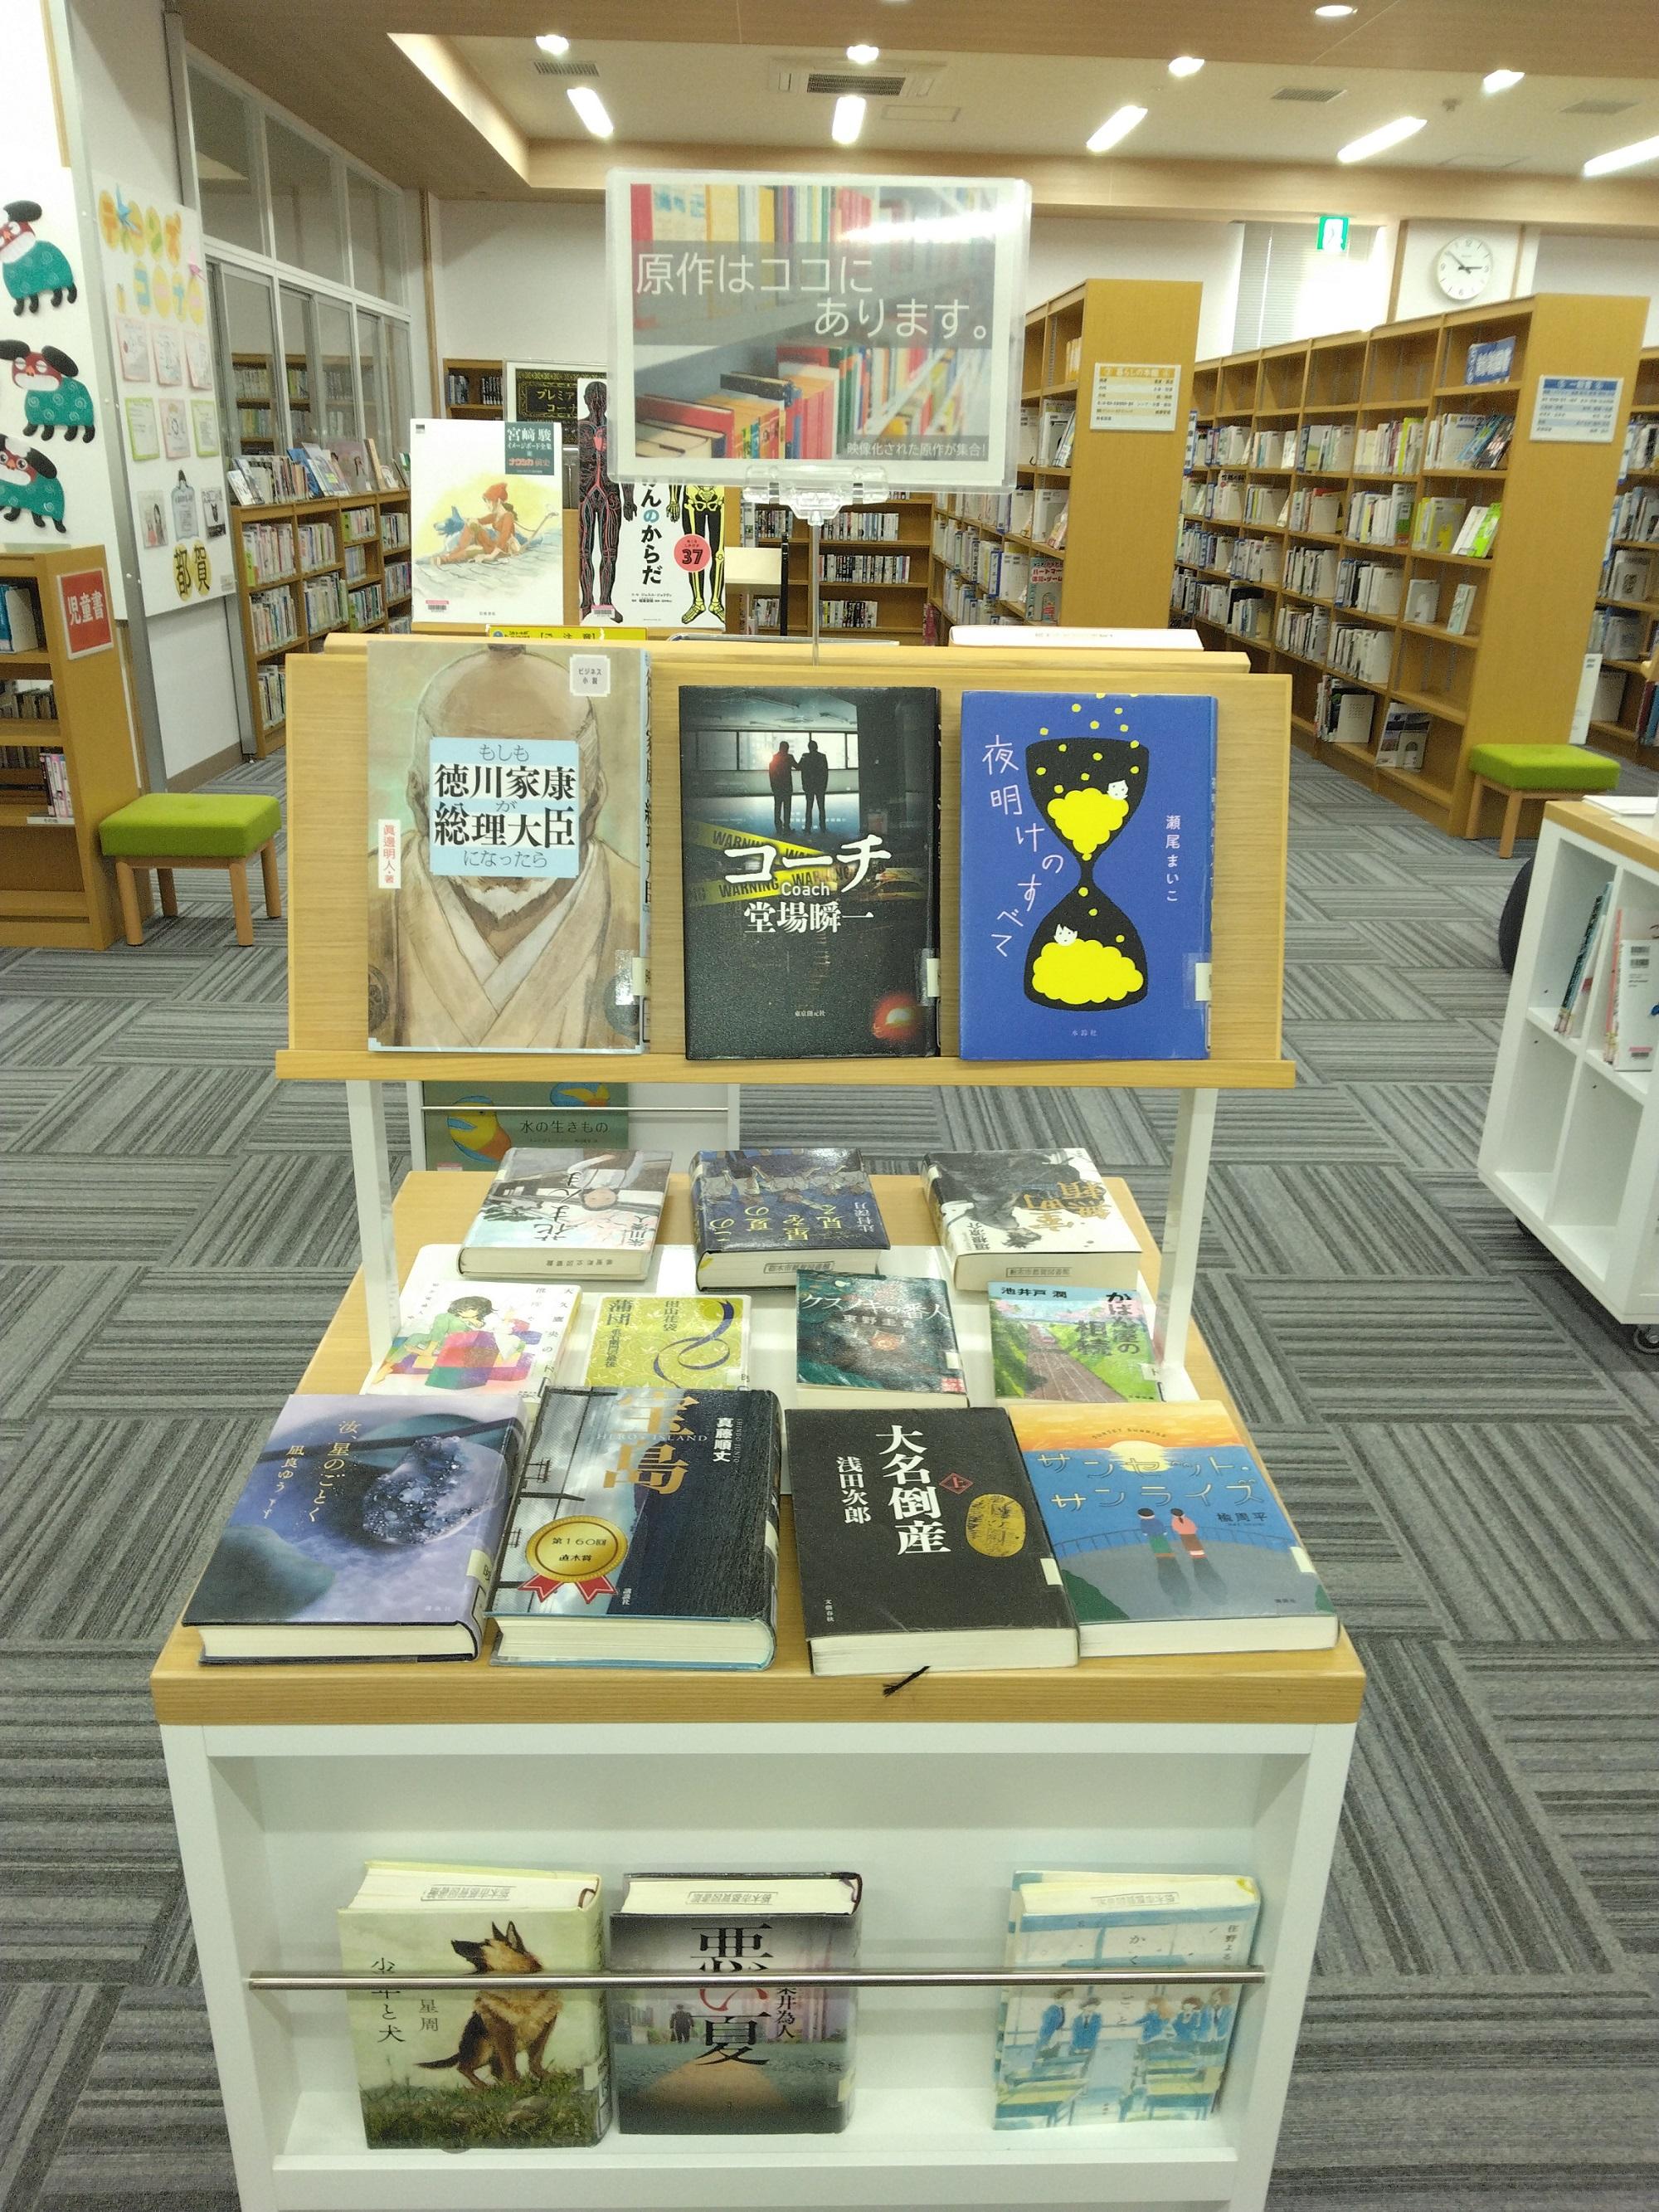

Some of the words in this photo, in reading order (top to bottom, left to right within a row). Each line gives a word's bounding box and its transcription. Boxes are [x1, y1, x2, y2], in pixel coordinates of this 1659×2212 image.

[635, 251, 873, 295] 原作はココに
[814, 297, 987, 340] あります。
[537, 389, 576, 401] プレミア
[547, 403, 578, 413] コーナ
[173, 544, 212, 597] 都賀
[682, 548, 703, 565] 37
[69, 589, 105, 626] 児童書
[577, 667, 603, 676] ビジネス
[581, 676, 599, 685] 小説
[478, 743, 530, 762] もしも
[434, 763, 577, 801] 徳川家康
[495, 799, 518, 814] が
[433, 801, 576, 850] 総理大臣
[463, 850, 548, 869] になったら
[723, 834, 893, 894] コーチ
[1165, 814, 1181, 903] 瀬尾まいこ
[781, 882, 830, 897] Coach
[743, 901, 874, 934] 堂場瞬一
[518, 1119, 609, 1134] 水の生きもの
[533, 1171, 584, 1242] 花まんま
[816, 1203, 845, 1230] 見る
[1056, 1181, 1113, 1220] 無頼
[708, 1217, 735, 1242] この
[744, 1205, 772, 1232] 夏の
[782, 1214, 810, 1241] 星を
[801, 1294, 951, 1322] クスノキの番人
[1000, 1286, 1047, 1297] 池井戸
[1052, 1289, 1068, 1299] 潤
[663, 1299, 680, 1332] 田山花袋
[842, 1314, 916, 1329] 東野圭吾
[1106, 1291, 1141, 1355] かばん屋の
[1075, 1319, 1112, 1357] 相続
[602, 1391, 701, 1495] 宝島
[652, 1434, 708, 1442] ISLAND
[713, 1416, 734, 1463] 真藤順丈
[1092, 1427, 1122, 1440] SUNSET
[1126, 1427, 1168, 1439] SUNRISE
[308, 1419, 363, 1523] 汝、星のごとく
[835, 1455, 872, 1525] 浅田次郎
[875, 1424, 951, 1557] 大名倒産
[1050, 1479, 1264, 1513] サンライズ
[558, 1553, 593, 1562] 直木賞
[419, 1998, 440, 2034] 星周
